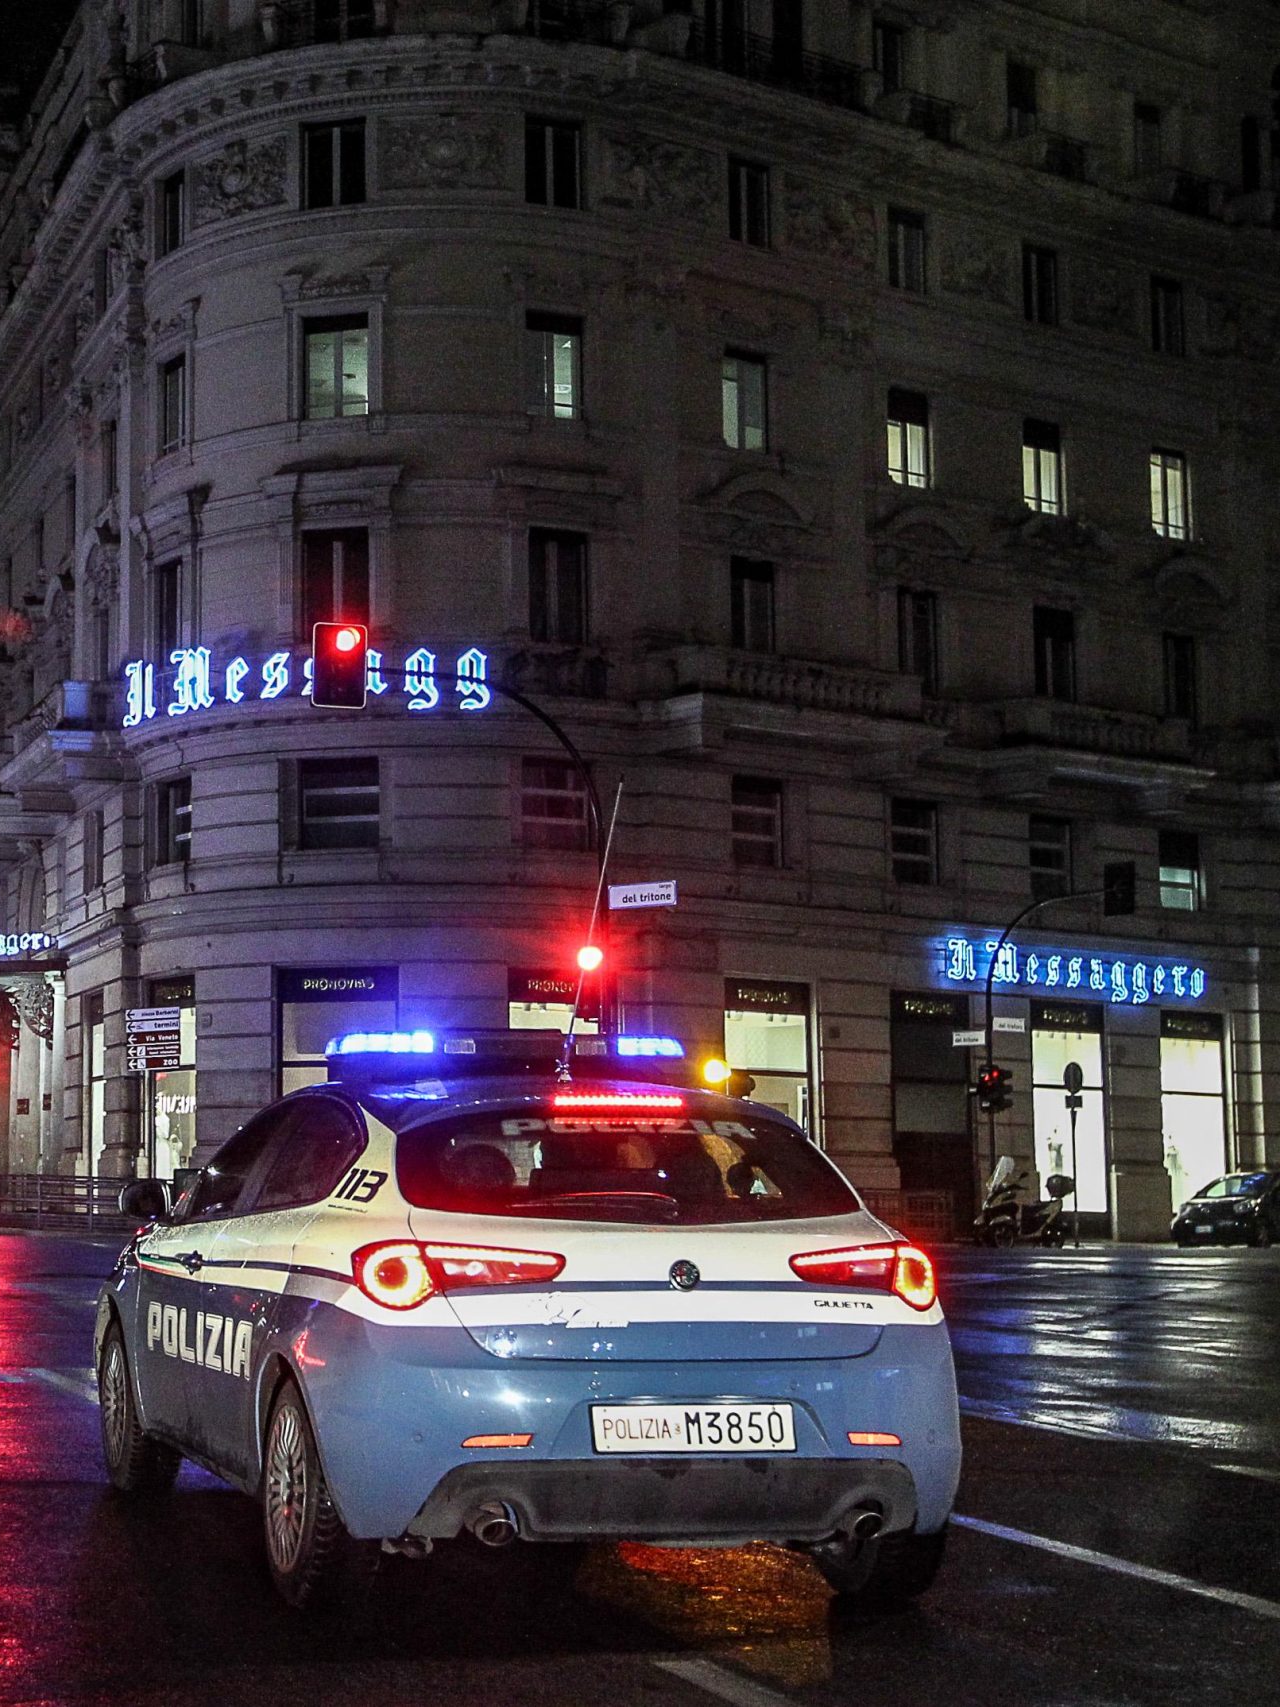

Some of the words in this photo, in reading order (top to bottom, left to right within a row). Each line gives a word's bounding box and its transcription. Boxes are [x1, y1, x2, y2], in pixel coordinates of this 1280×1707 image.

[123, 660, 156, 727] Il
[622, 894, 636, 903] del
[640, 893, 671, 902] tritone
[947, 938, 976, 981] Il
[985, 940, 1205, 1004] Messaggero
[154, 1020, 179, 1028] termini
[500, 1117, 758, 1141] POLIZIA
[334, 1168, 389, 1203] 113
[147, 1301, 253, 1381] POLIZIA
[602, 1417, 672, 1440] POLIZIA
[684, 1411, 785, 1445] M3850
